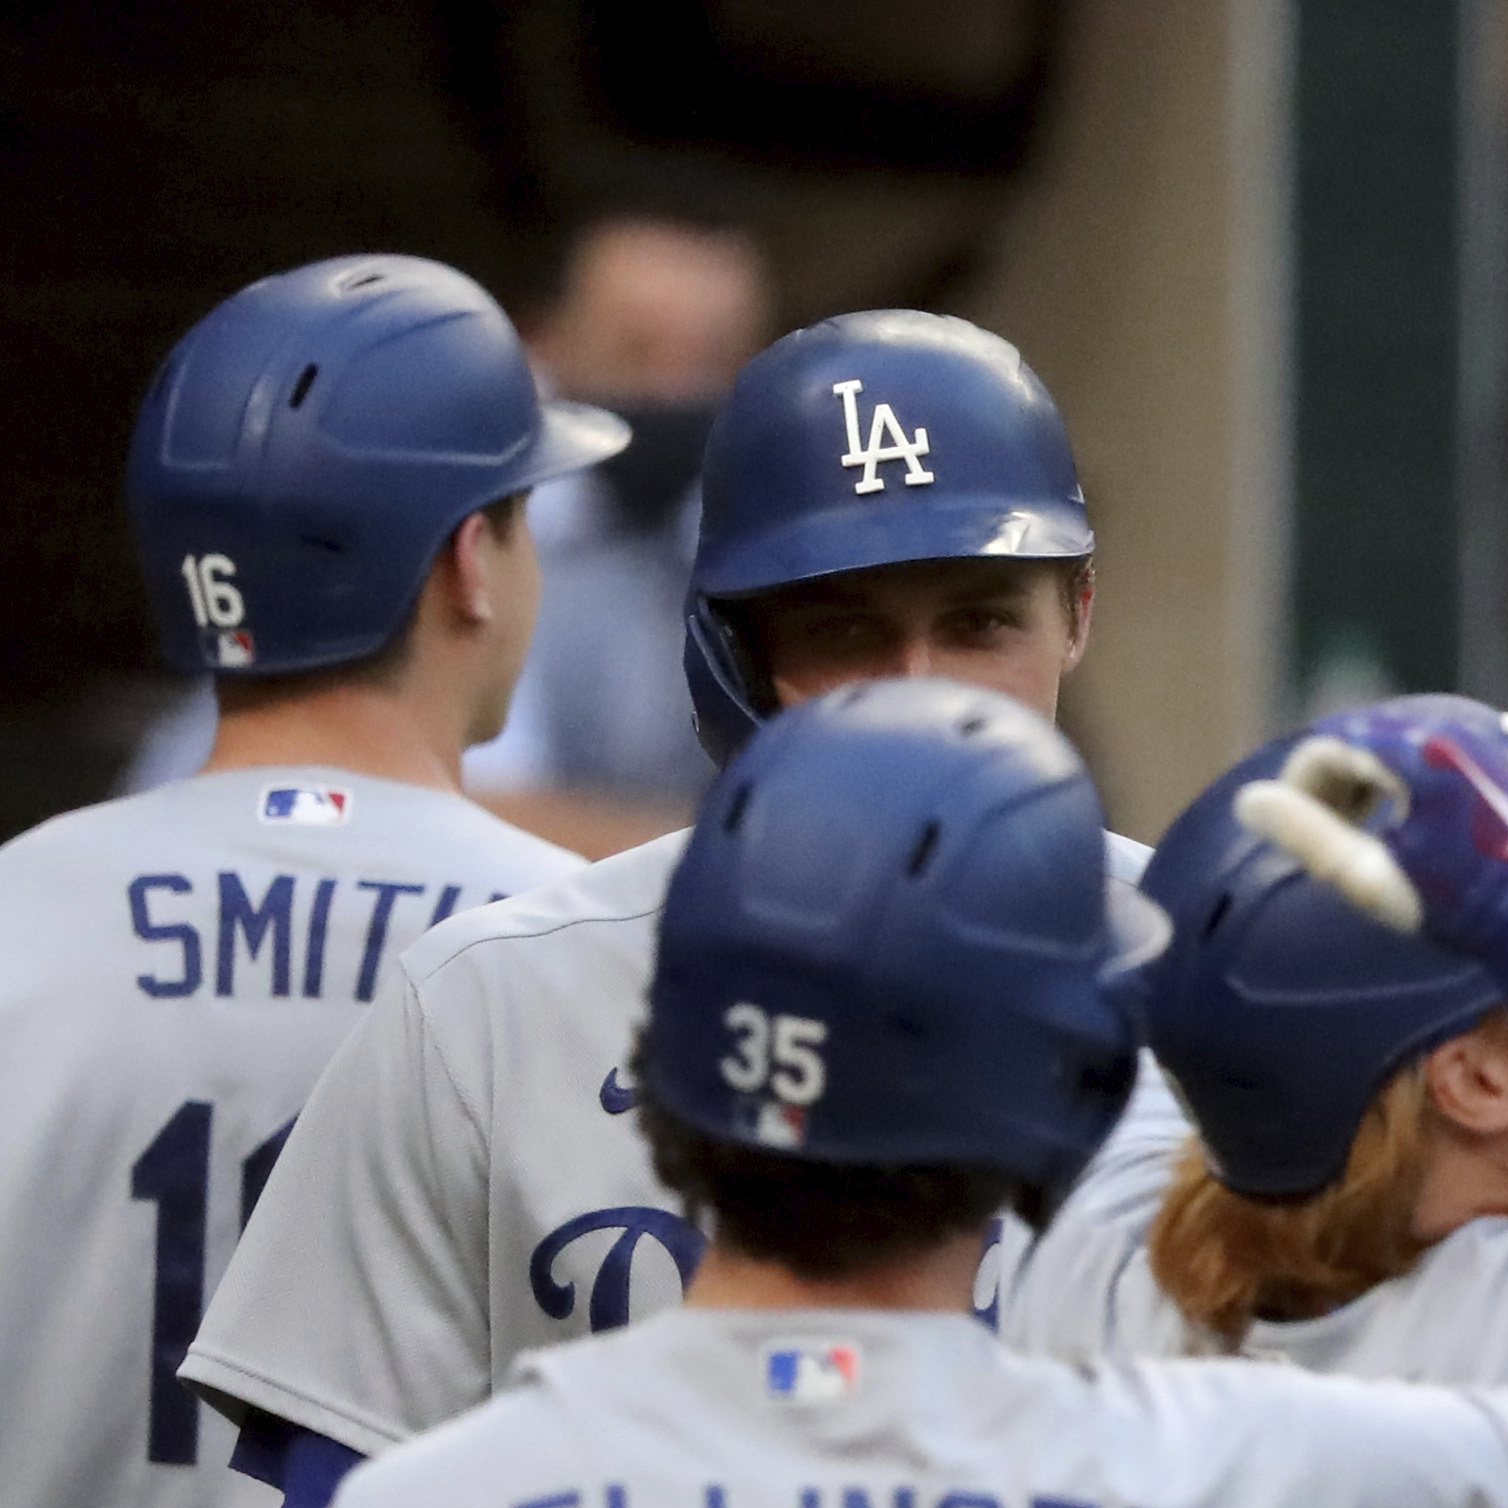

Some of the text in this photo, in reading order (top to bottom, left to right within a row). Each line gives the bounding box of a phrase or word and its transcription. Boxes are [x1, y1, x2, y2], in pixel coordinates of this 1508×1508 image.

[832, 379, 935, 495] LA
[181, 553, 248, 629] 16
[127, 870, 515, 1004] SMIT
[720, 1001, 829, 1107] 35
[130, 1100, 304, 1466] 1
